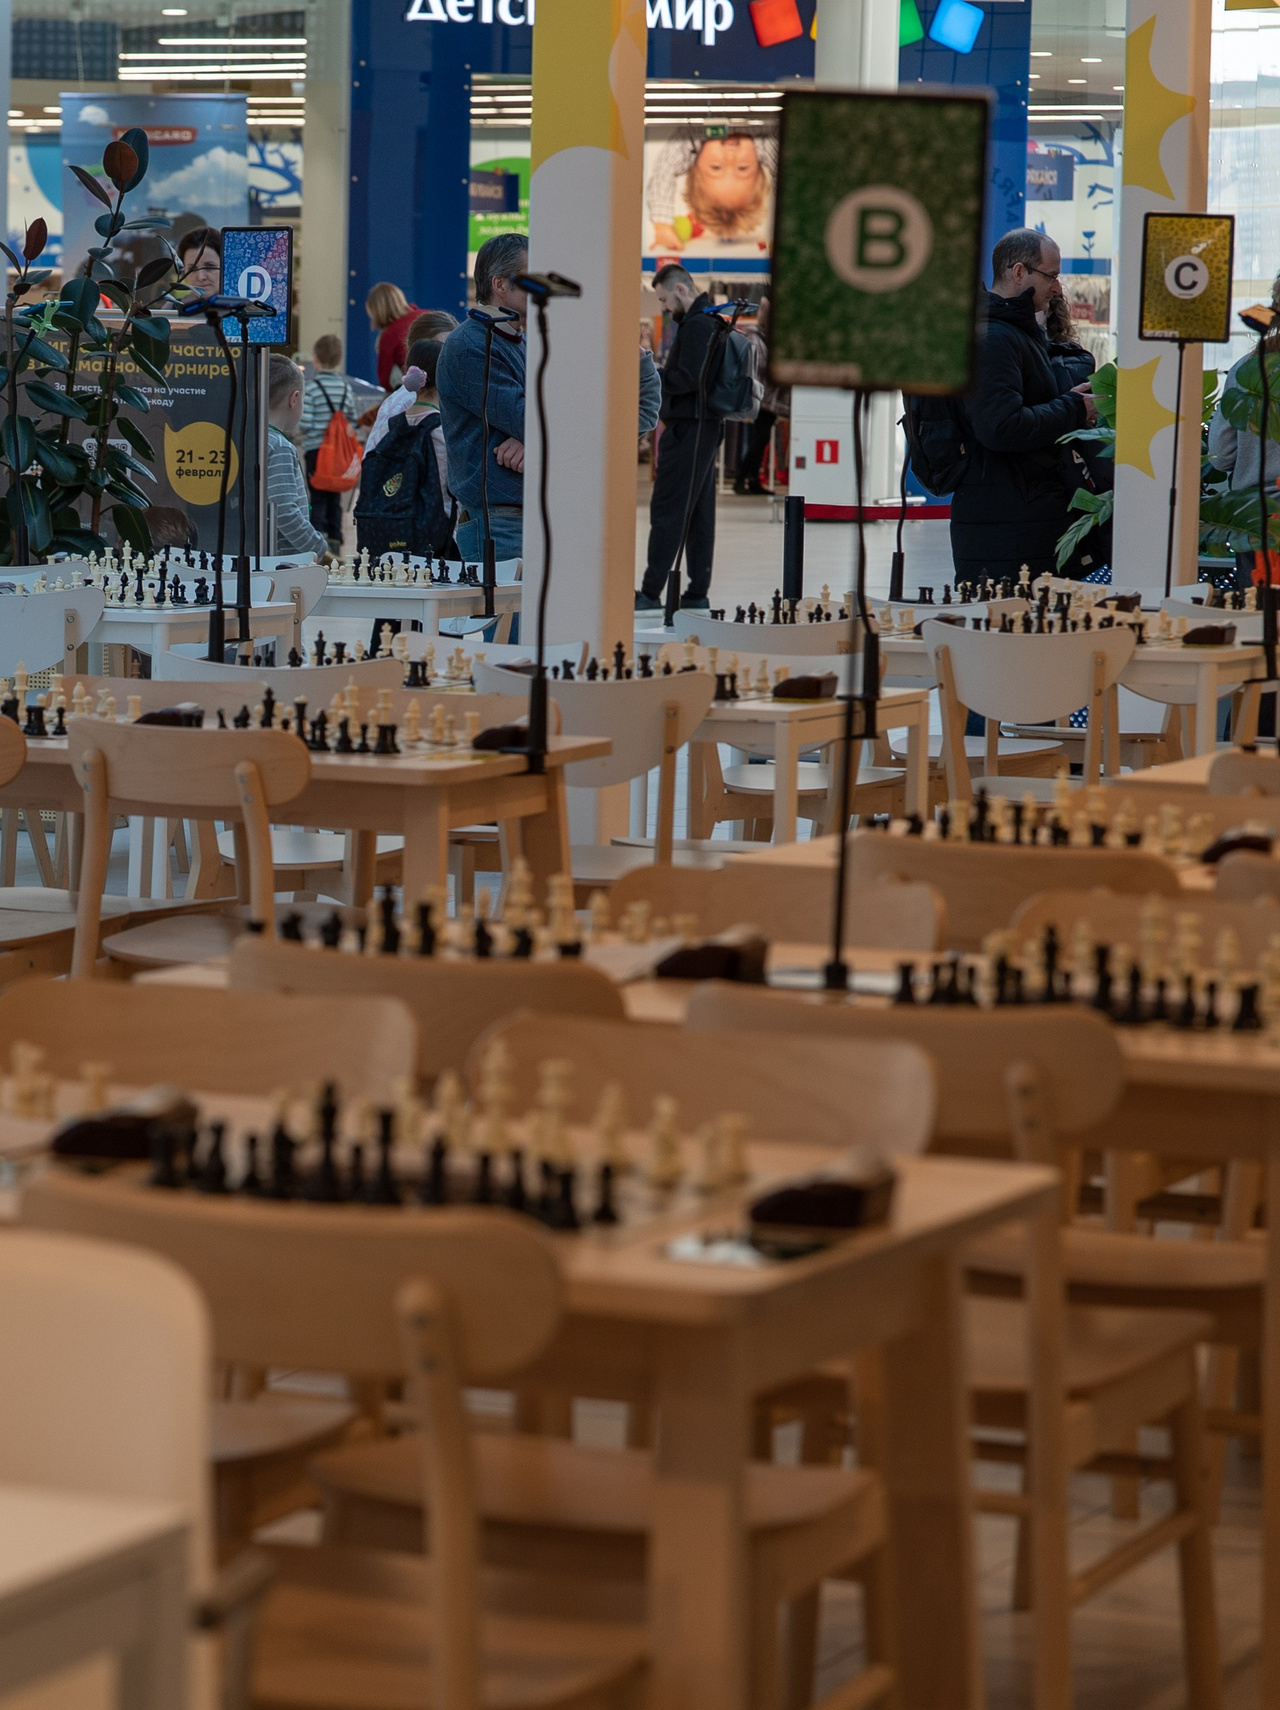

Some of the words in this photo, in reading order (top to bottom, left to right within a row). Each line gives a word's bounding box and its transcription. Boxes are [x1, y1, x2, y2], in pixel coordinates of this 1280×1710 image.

[406, 0, 535, 26] Детс
[858, 209, 907, 268] B
[247, 272, 266, 298] D
[1174, 262, 1199, 291] C
[168, 388, 207, 396] участие
[176, 450, 194, 463] 21
